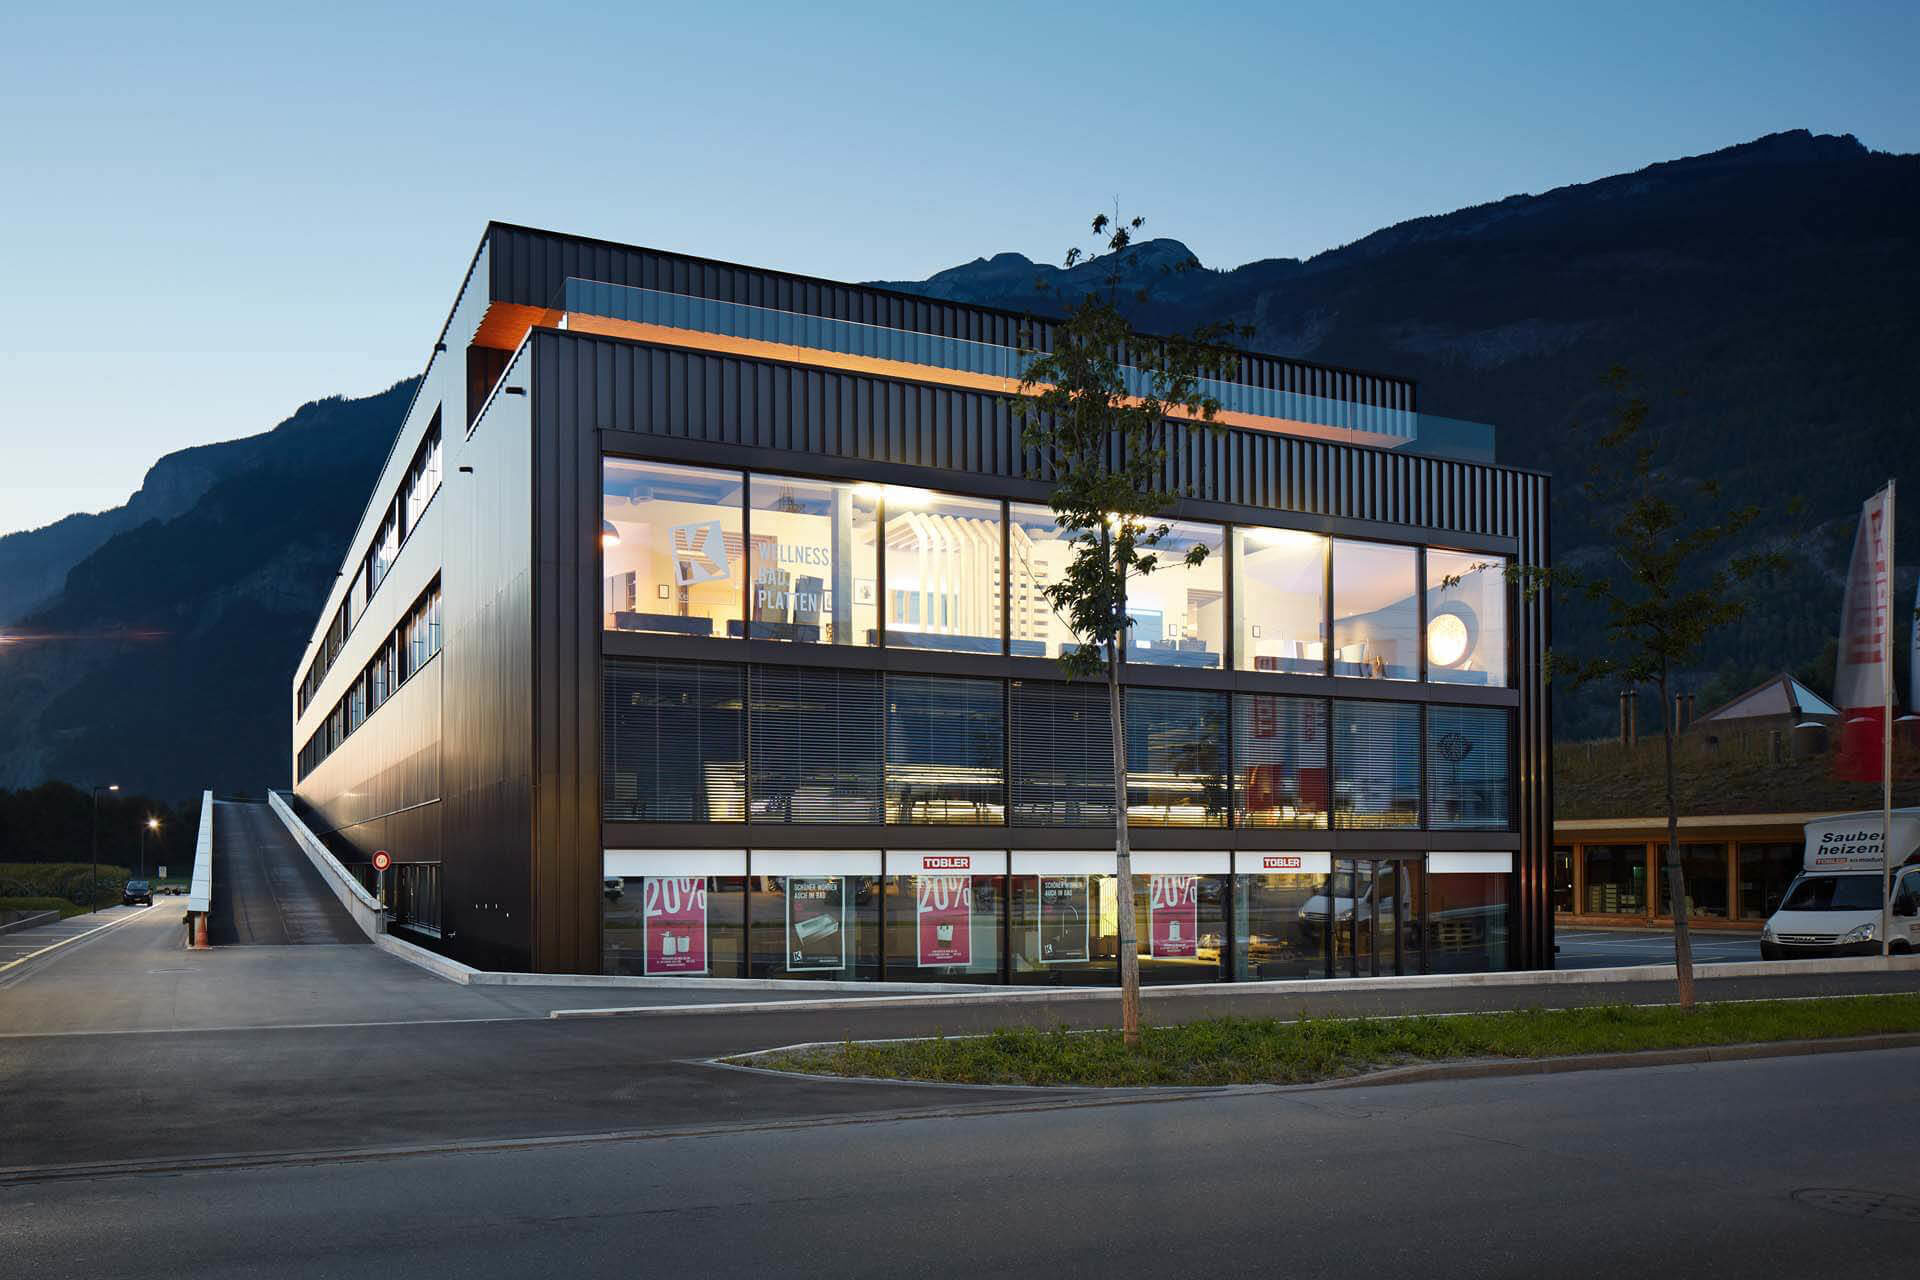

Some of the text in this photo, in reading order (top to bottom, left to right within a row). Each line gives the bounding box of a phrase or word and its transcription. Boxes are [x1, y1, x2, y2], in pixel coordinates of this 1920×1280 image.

[758, 590, 817, 612] PLATTEN
[924, 858, 969, 868] TOBLER
[1264, 858, 1300, 867] TOBLER
[645, 877, 705, 916] 20%
[918, 875, 970, 912] 20%
[1151, 874, 1197, 909] 20%
